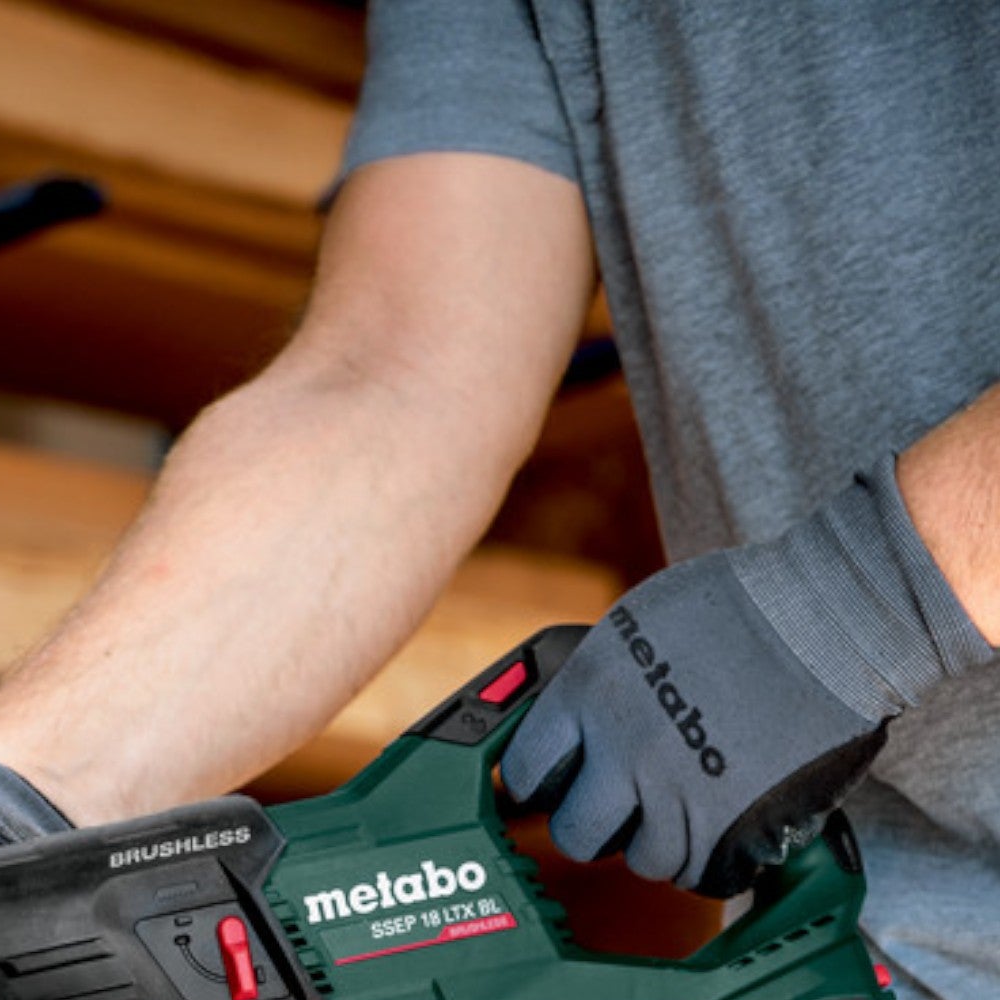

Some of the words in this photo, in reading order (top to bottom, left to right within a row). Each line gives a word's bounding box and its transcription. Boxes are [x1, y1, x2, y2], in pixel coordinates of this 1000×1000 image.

[609, 606, 727, 777] metabo
[110, 826, 252, 869] BRUSHLESS
[304, 860, 487, 923] metabo
[371, 914, 416, 939] SSEP
[420, 909, 441, 928] 18
[442, 901, 476, 923] LTX
[478, 897, 501, 917] BL
